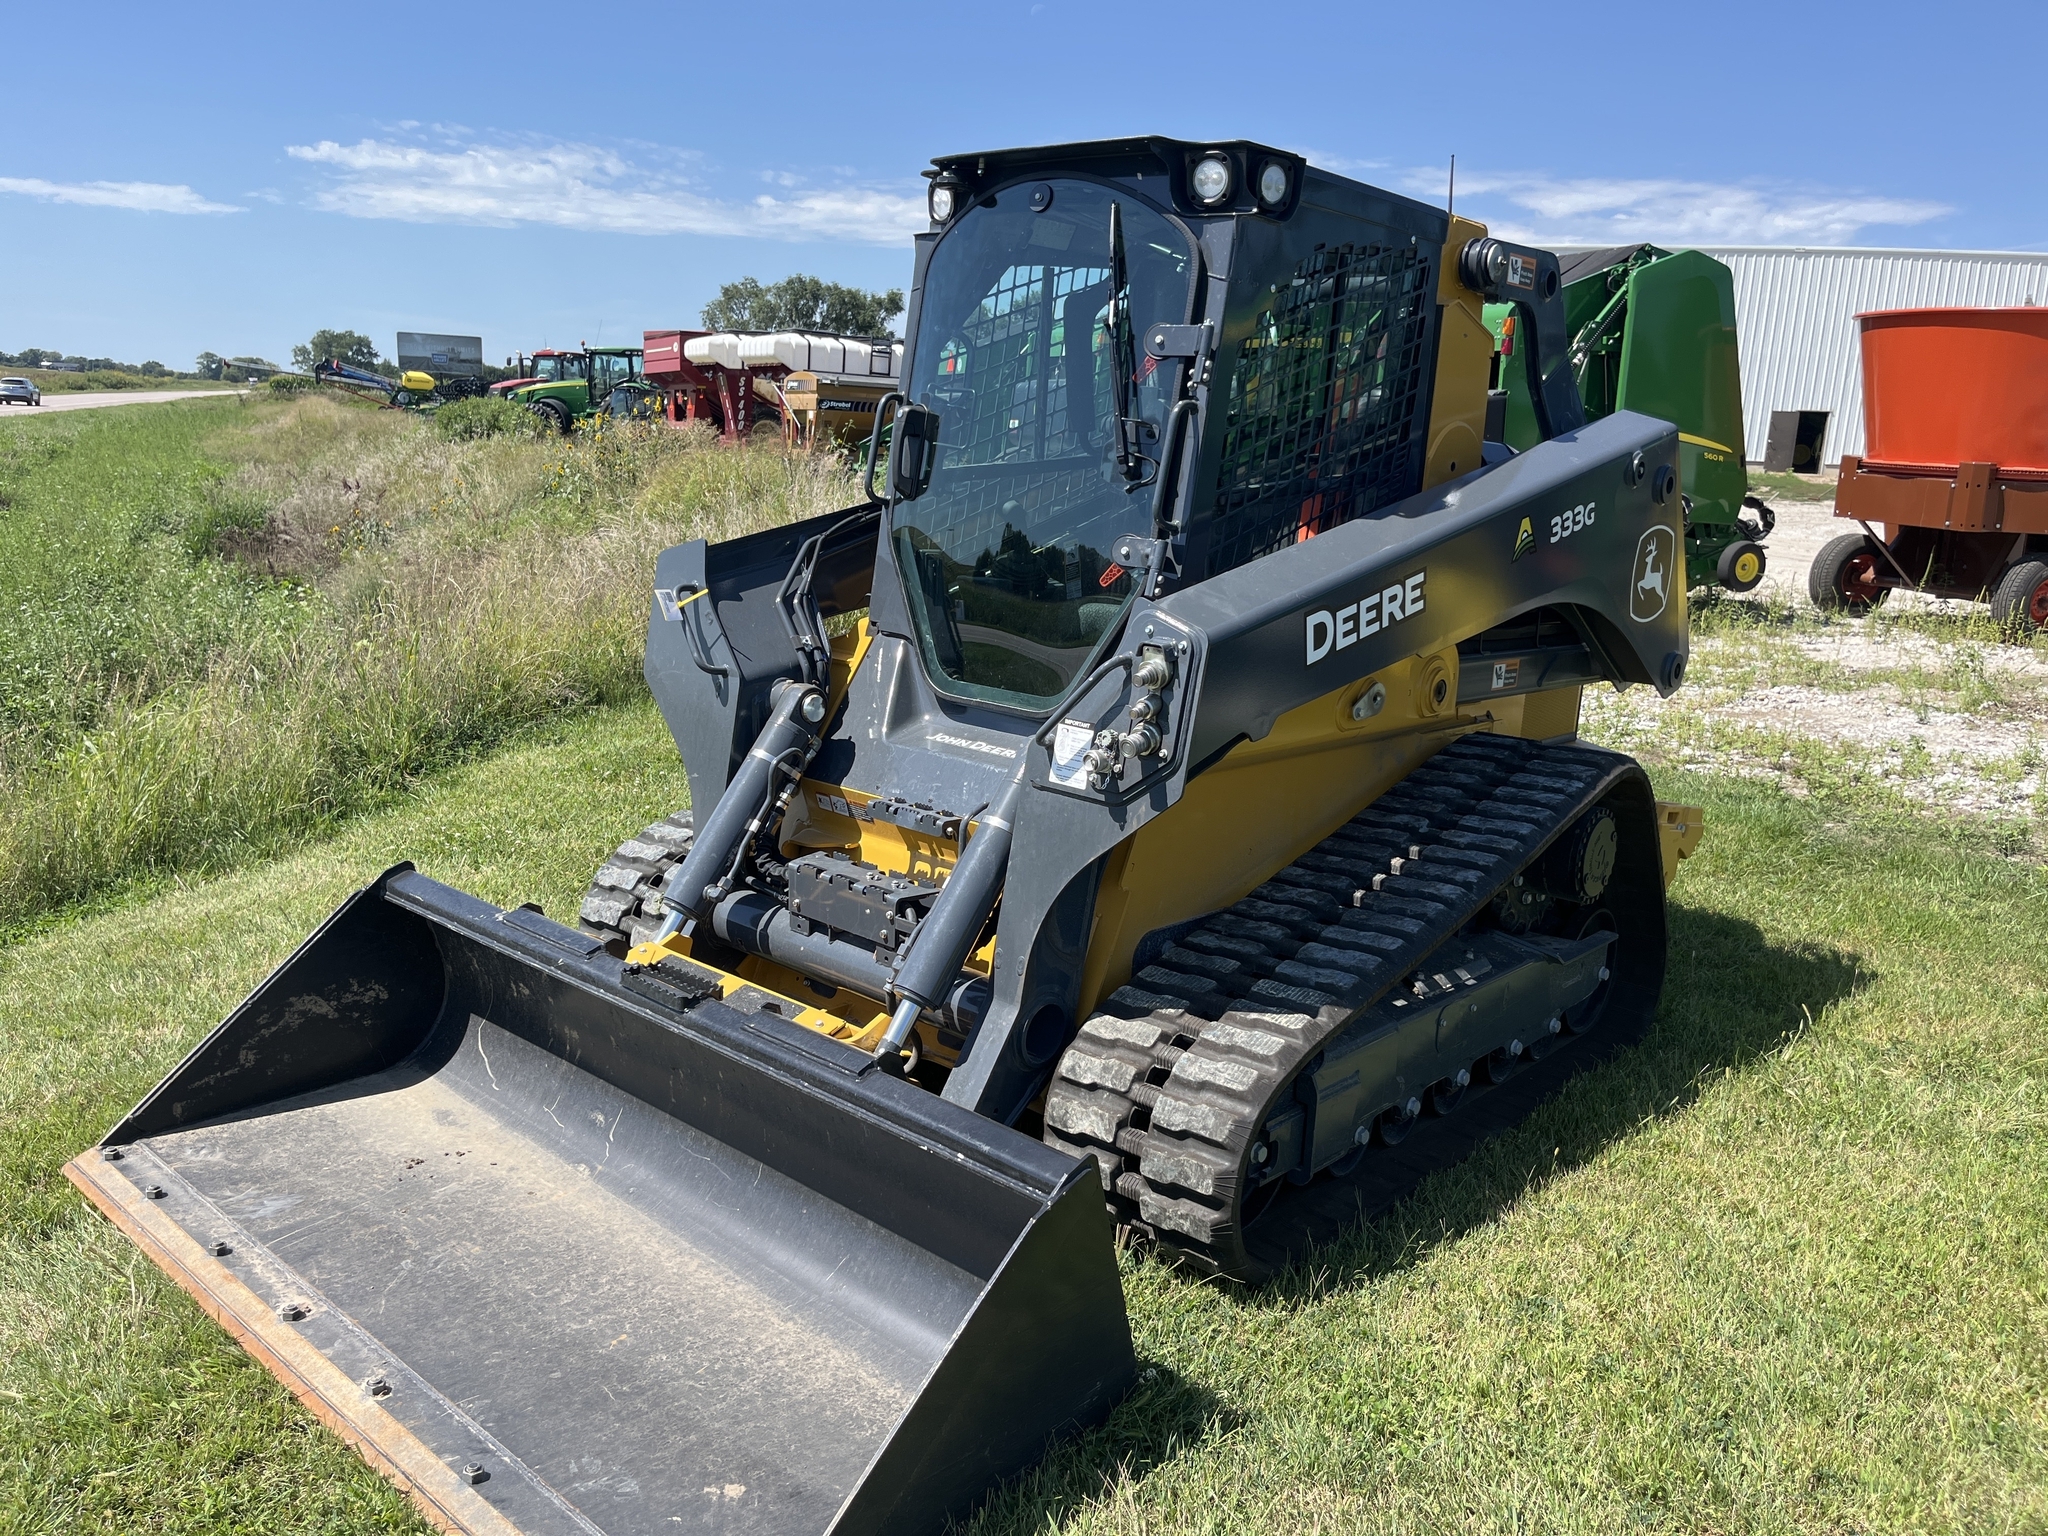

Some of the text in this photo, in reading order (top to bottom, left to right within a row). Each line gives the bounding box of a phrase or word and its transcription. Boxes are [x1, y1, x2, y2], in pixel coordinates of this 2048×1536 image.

[1550, 502, 1596, 544] 333G
[1306, 571, 1425, 666] DEERE
[1064, 718, 1091, 729] IMPORTANT
[926, 733, 1017, 759] JOHN DEER
